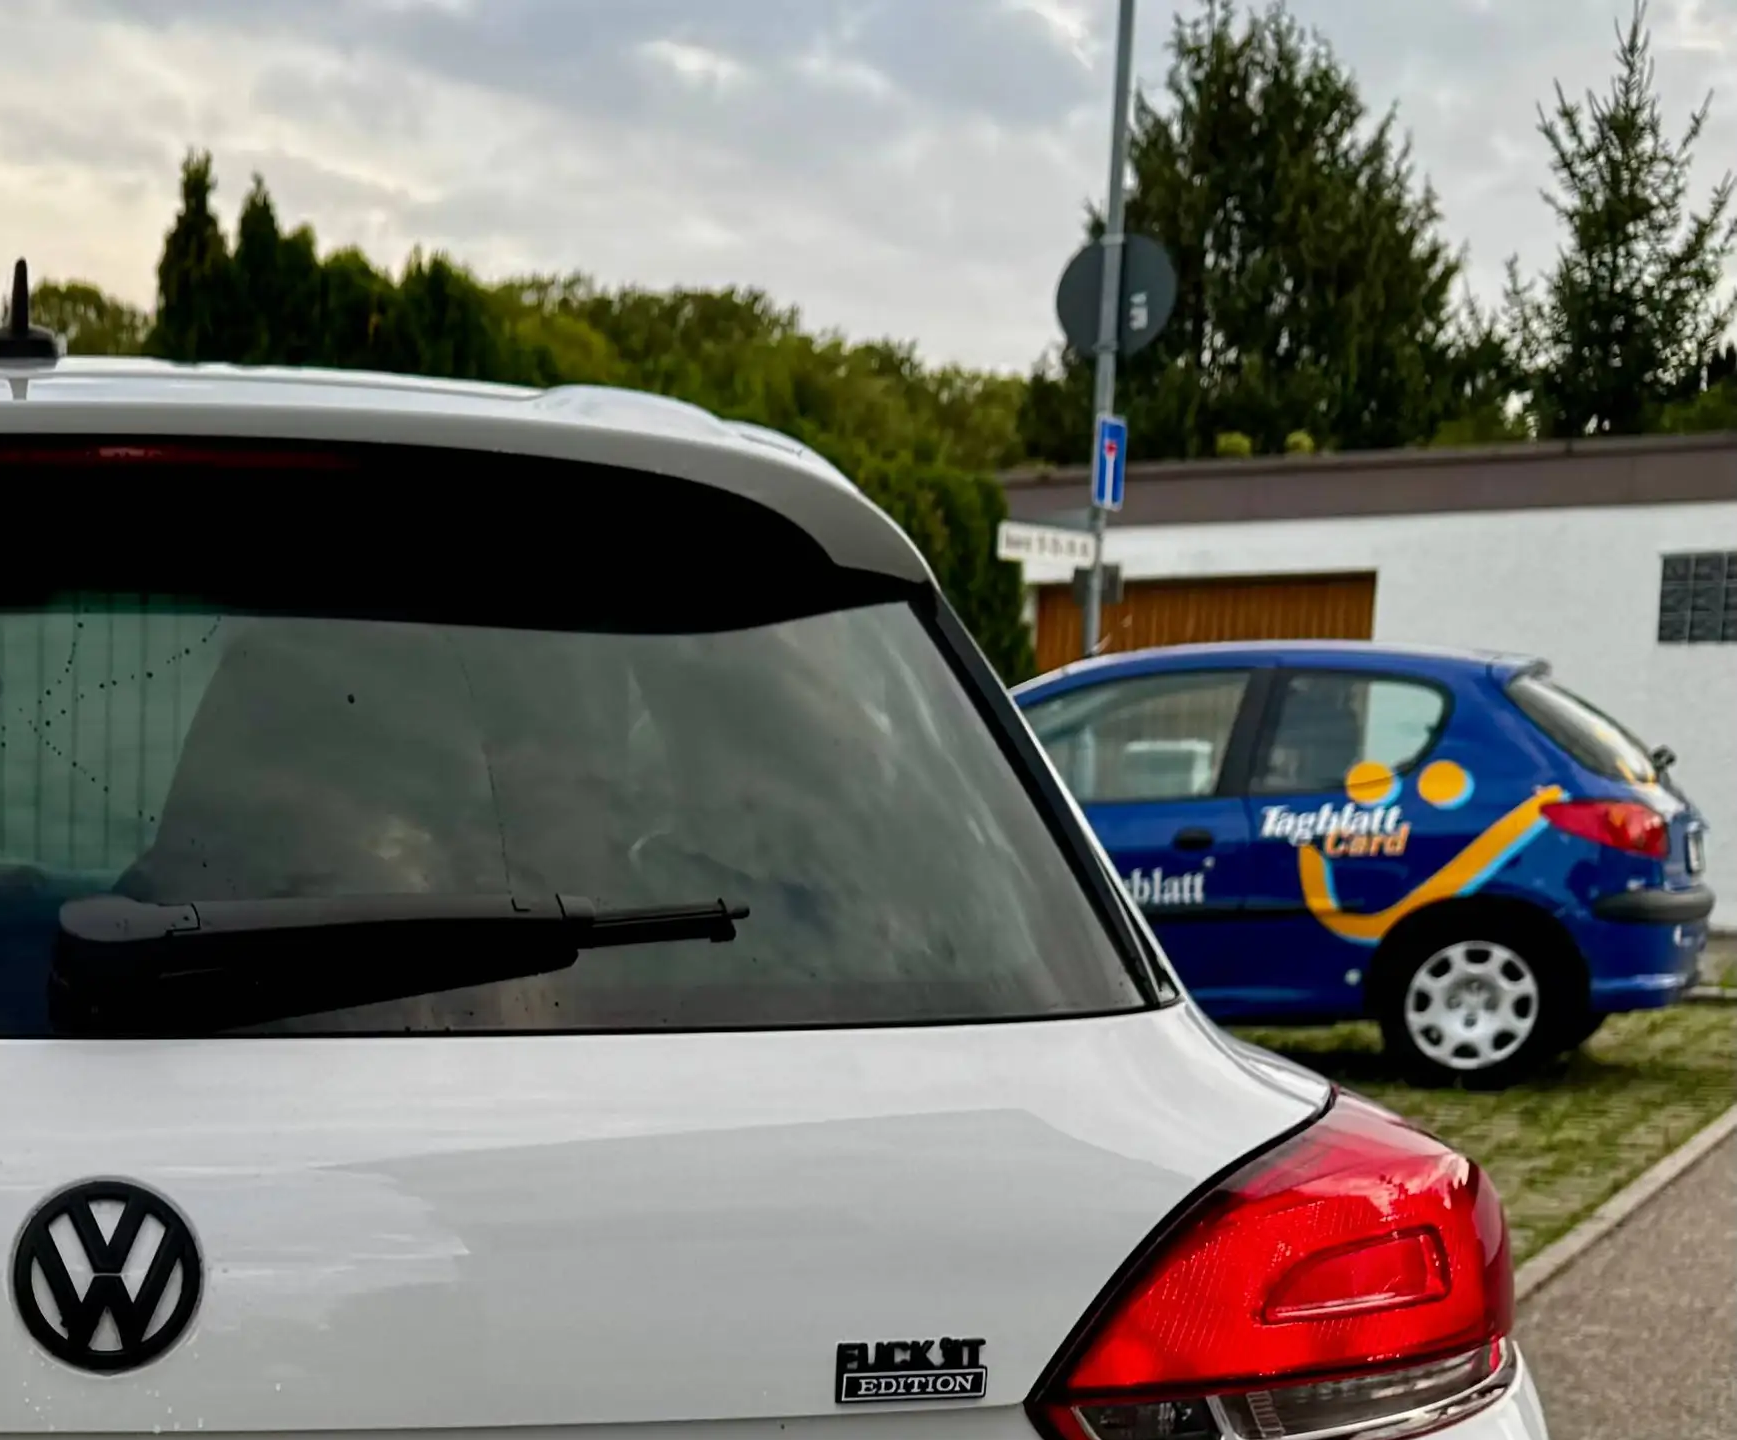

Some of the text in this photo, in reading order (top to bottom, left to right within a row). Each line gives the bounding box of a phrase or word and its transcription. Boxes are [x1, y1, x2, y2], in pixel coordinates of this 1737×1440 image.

[1260, 802, 1404, 846] Tagblatt
[1324, 822, 1411, 857] Card
[857, 1374, 974, 1395] EDITION
